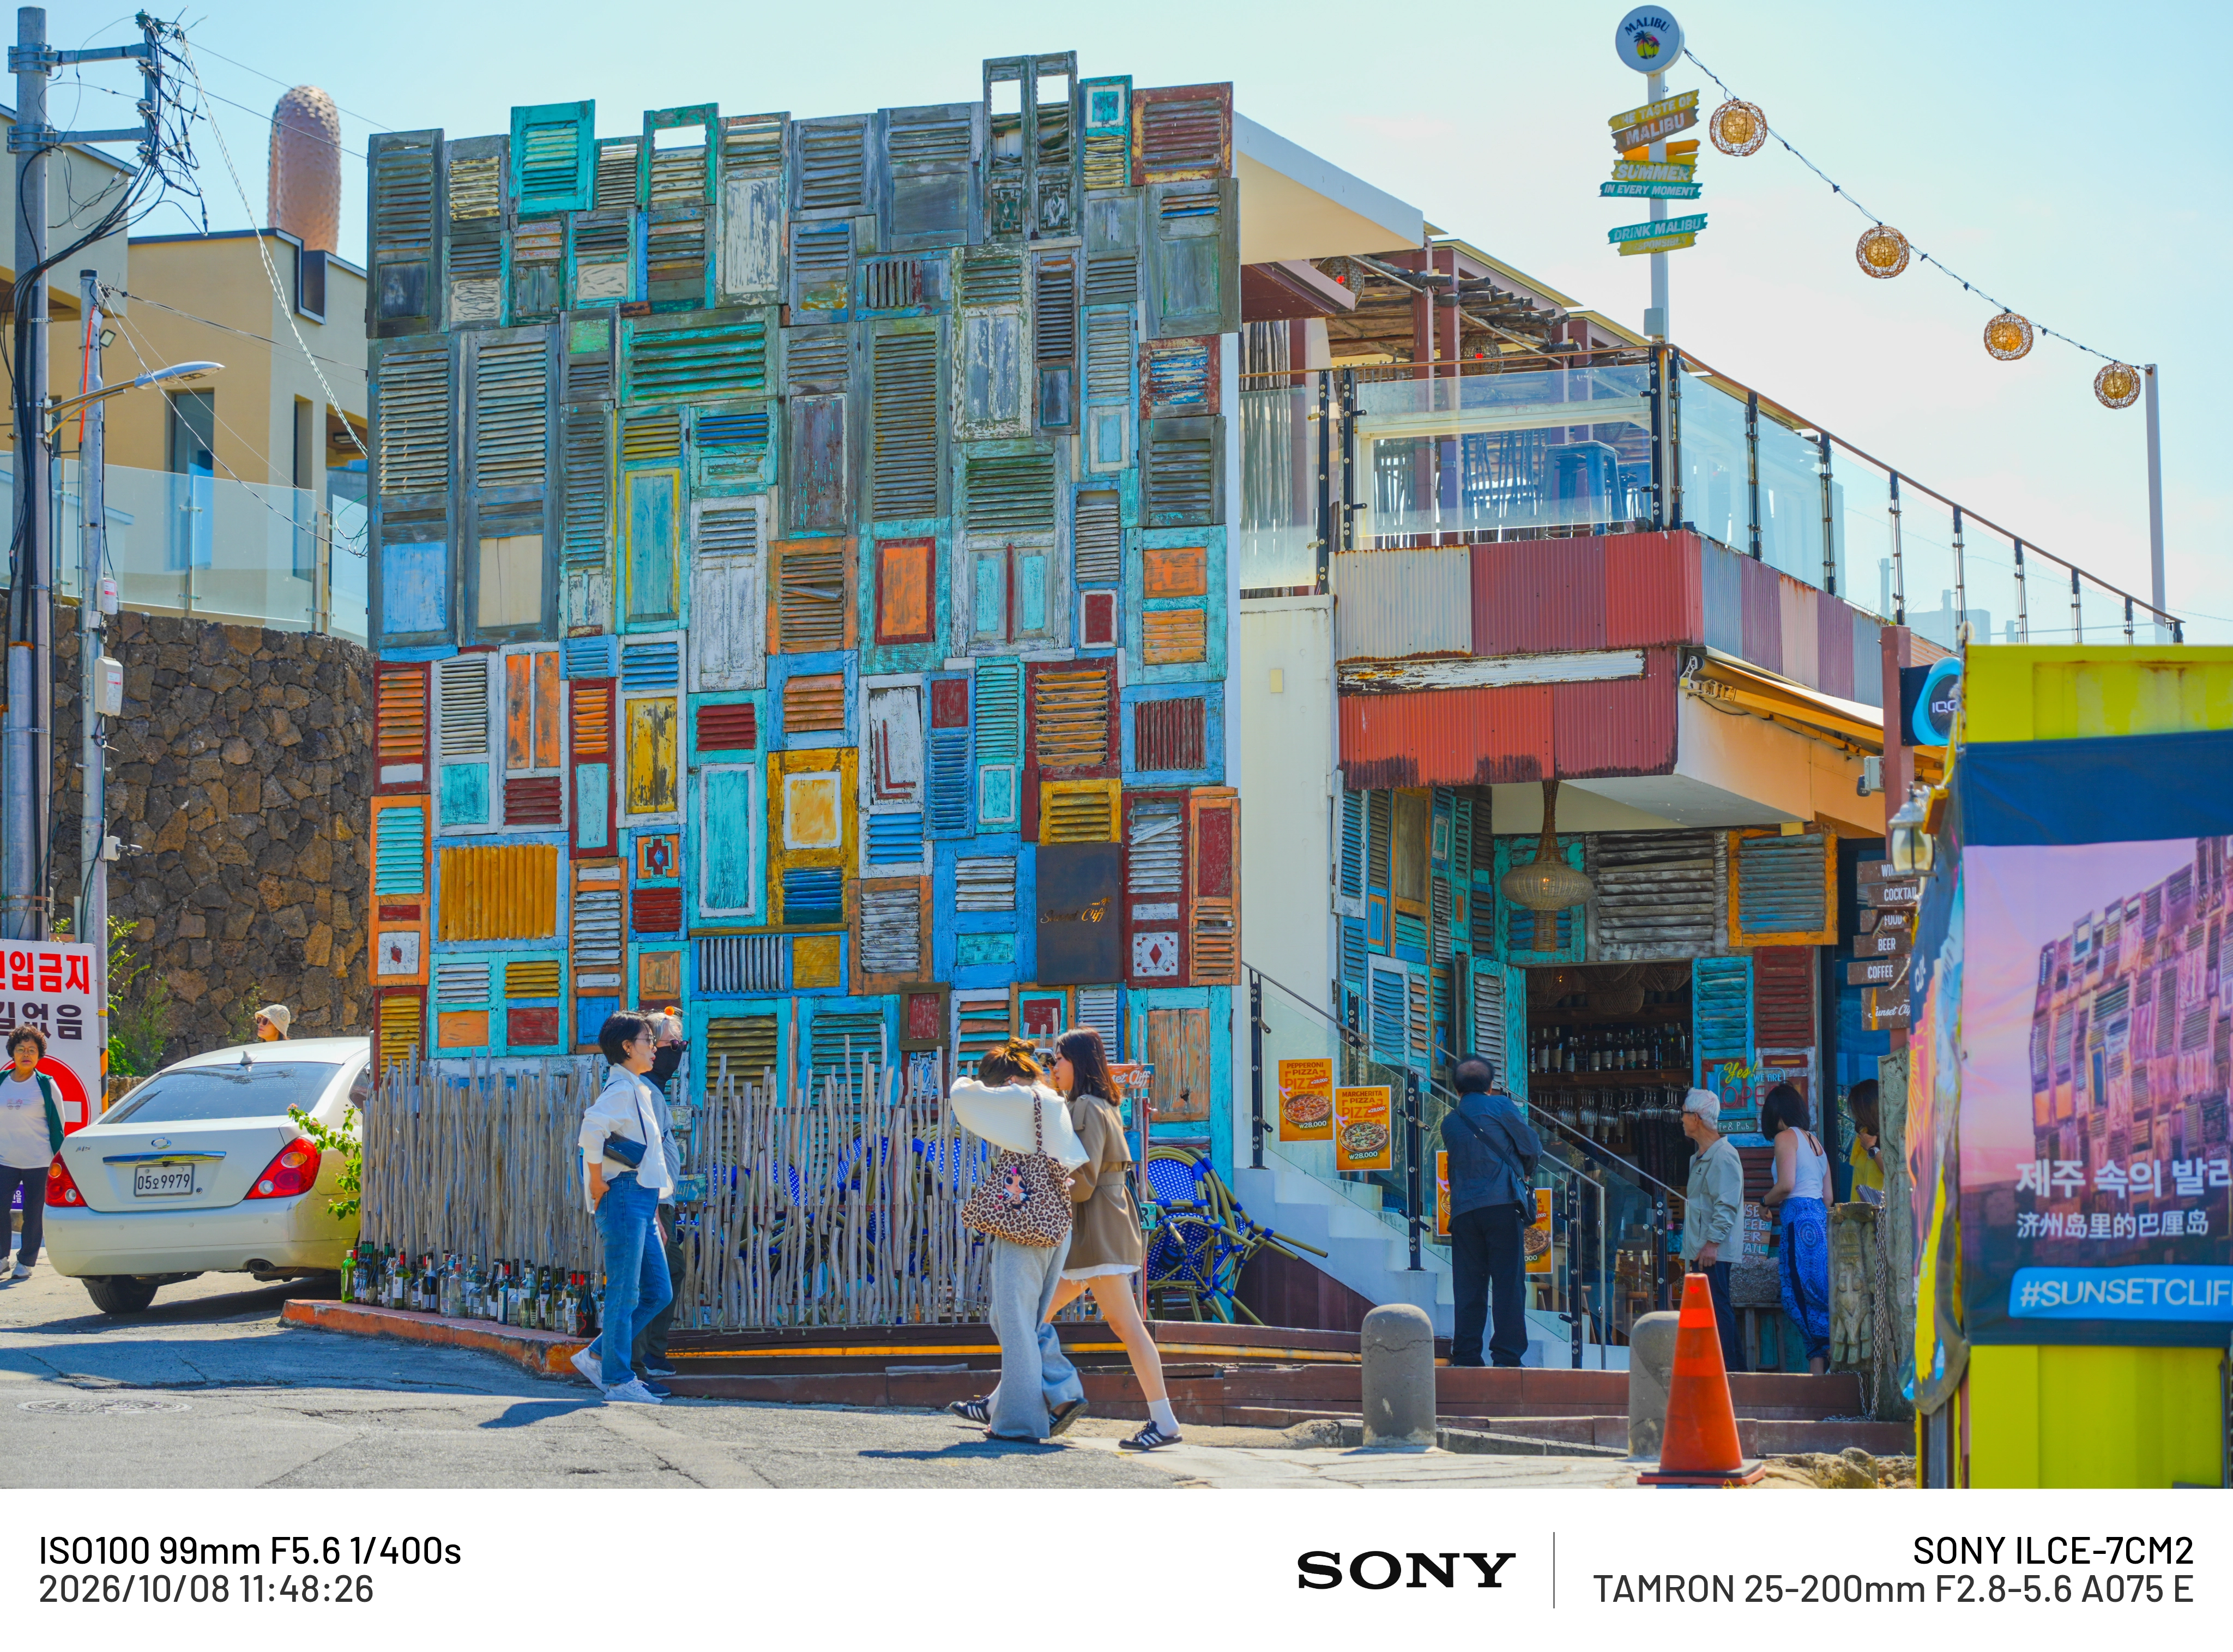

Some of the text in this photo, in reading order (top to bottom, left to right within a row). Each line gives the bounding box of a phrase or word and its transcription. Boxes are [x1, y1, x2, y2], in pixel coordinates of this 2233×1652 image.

[1625, 17, 1670, 36] MALIBU
[1617, 95, 1693, 125] HE TASTE OF
[1626, 113, 1685, 146] MALIBU
[1616, 164, 1690, 181] SUMMER
[1604, 184, 1697, 196] IN EVERY MOMENT
[1614, 218, 1701, 240] DRINK MALIBU
[1932, 700, 1957, 713] IQO
[1878, 938, 1896, 951] BEER
[1867, 964, 1893, 979] COFFEE
[1129, 1070, 1151, 1087] Cliff
[1724, 1061, 1758, 1084] Yes!
[1753, 1073, 1782, 1082] WE ARE
[1723, 1085, 1777, 1107] OPE
[1736, 1122, 1749, 1131] Pub
[137, 1174, 190, 1190] 05오9979
[2015, 1159, 2086, 1198] 제주
[2094, 1159, 2162, 1198] 속의
[1745, 1219, 1766, 1231] FEE
[2017, 1209, 2210, 1239] 济州岛里的巴厘岛
[2019, 1277, 2233, 1307] #SUNSETCLIF
